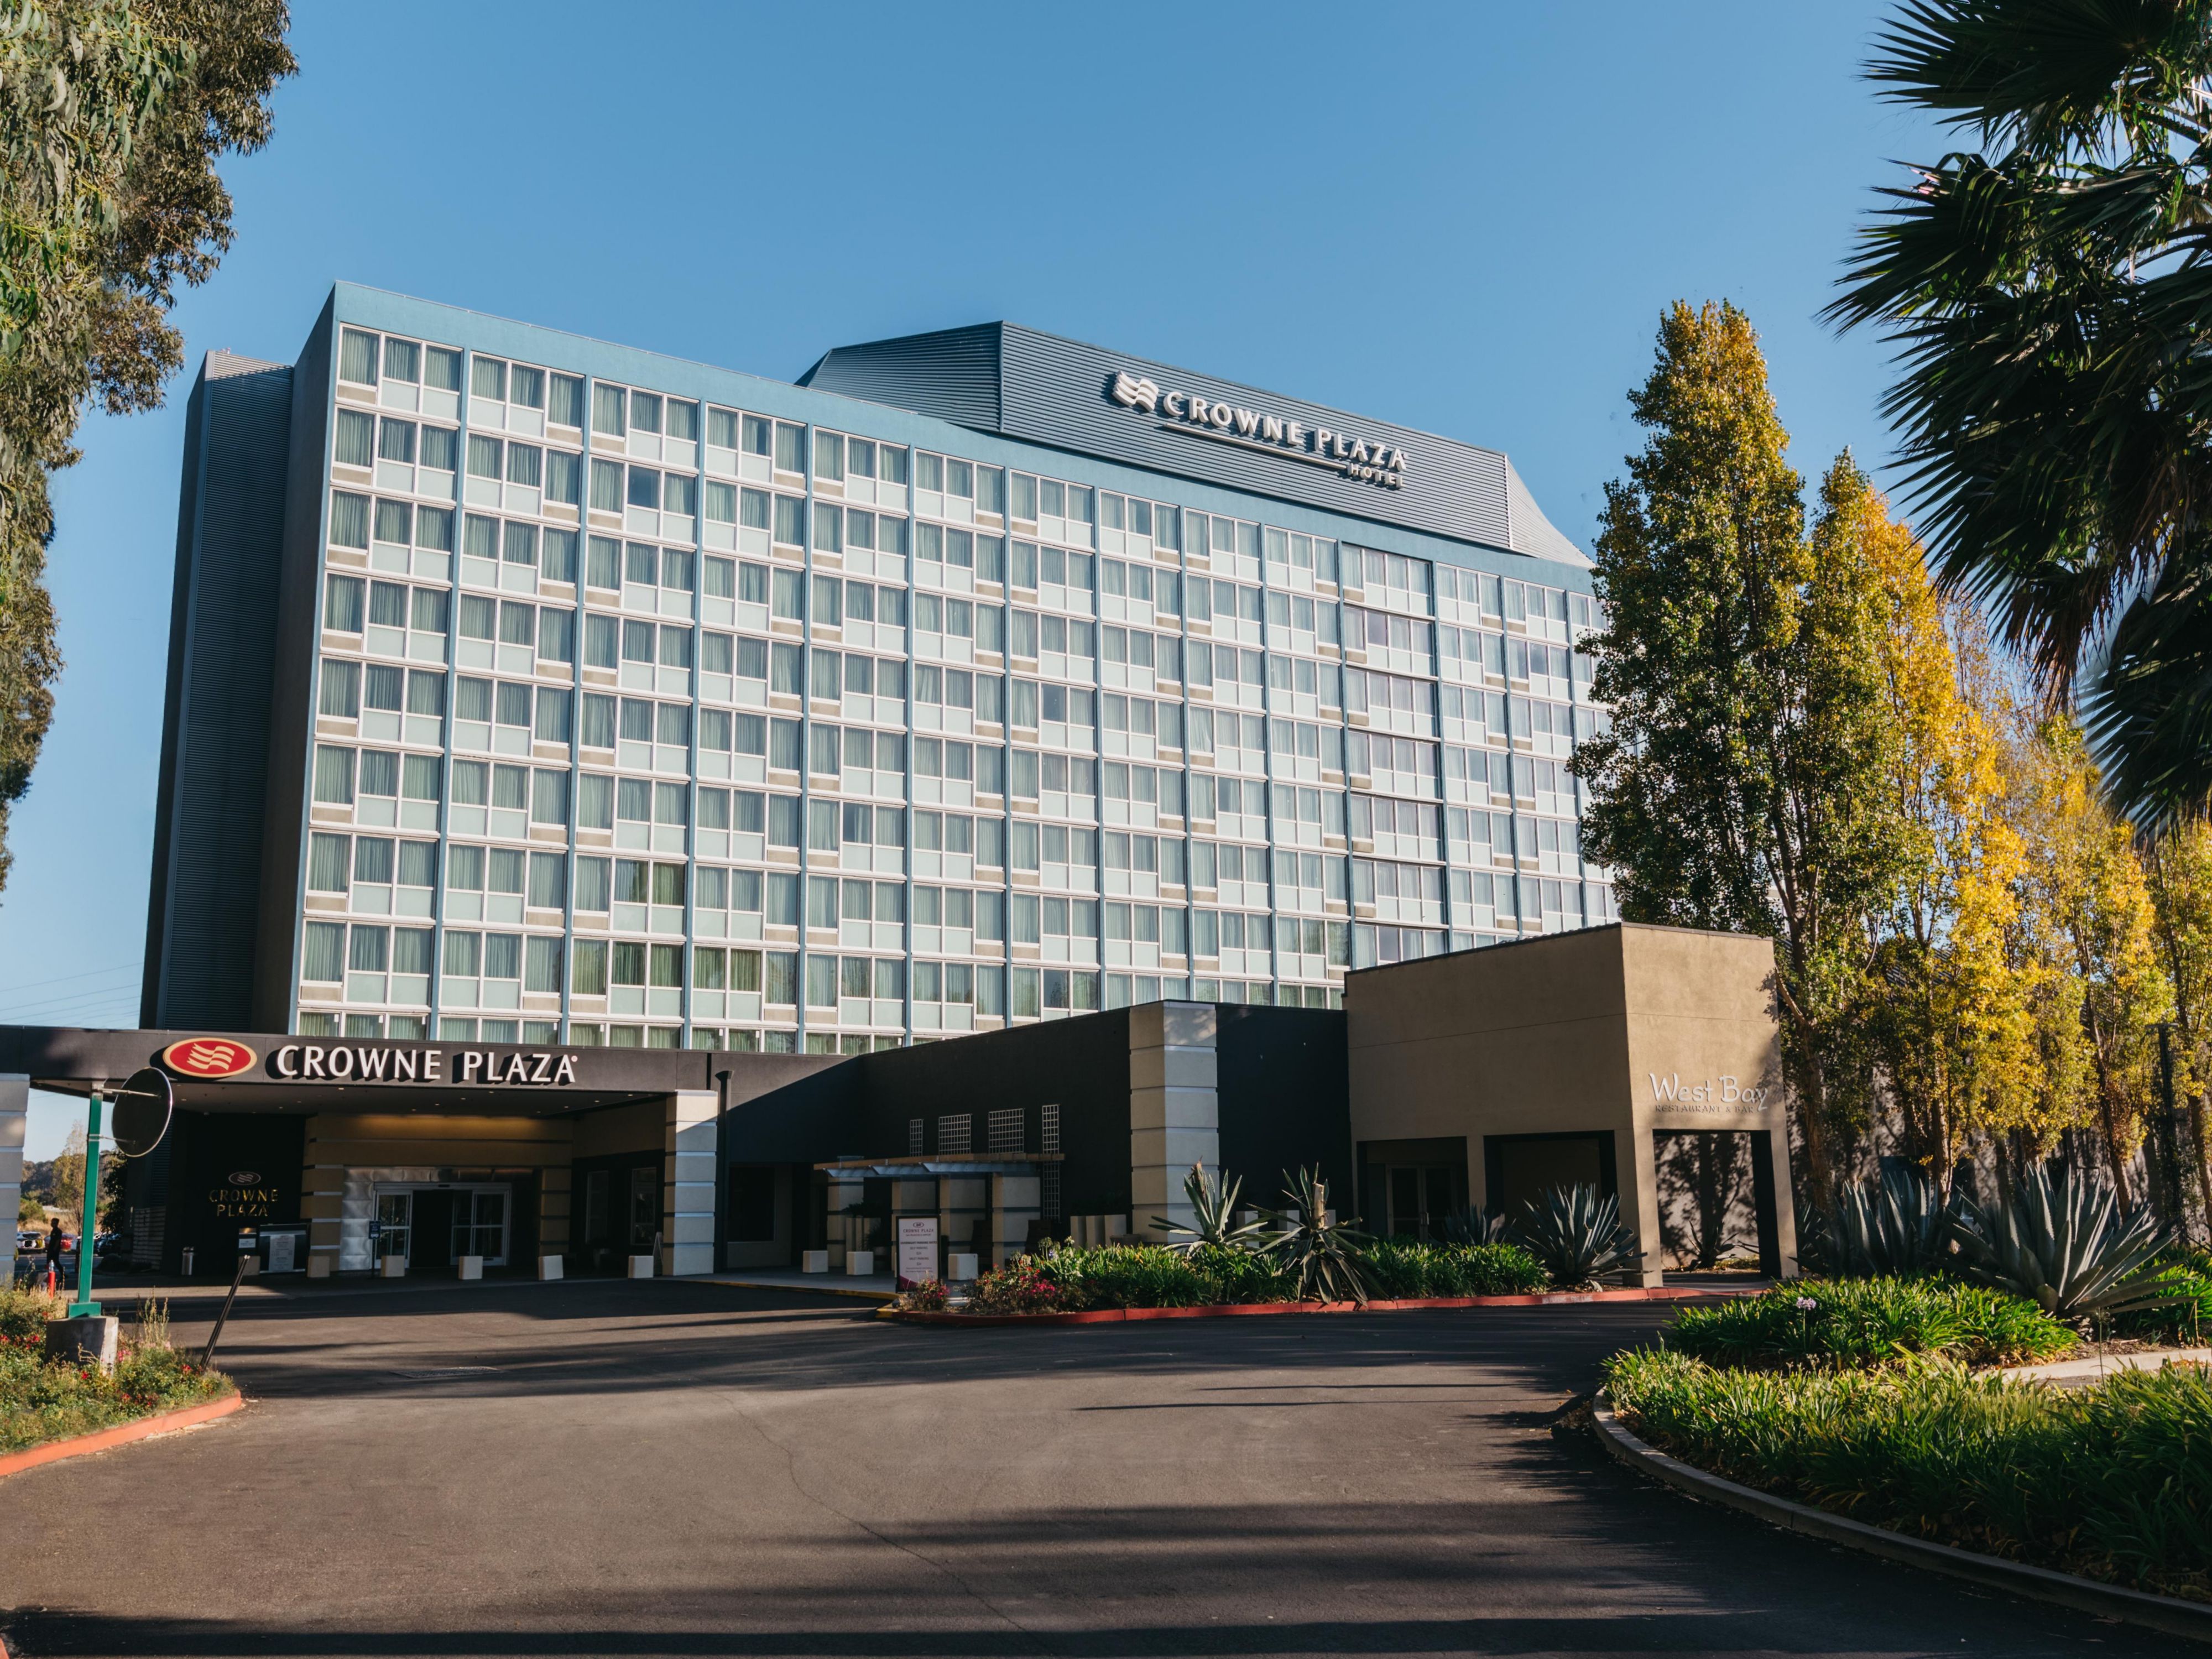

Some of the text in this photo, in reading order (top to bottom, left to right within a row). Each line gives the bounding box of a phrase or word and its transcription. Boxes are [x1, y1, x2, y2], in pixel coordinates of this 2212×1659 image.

[1164, 392, 1408, 471] CROWNE PLAZA
[1348, 462, 1406, 489] HOTEL
[277, 1045, 578, 1083] CROWNE PLAZA
[1648, 1073, 1768, 1111] West Bay
[1655, 1105, 1720, 1113] RESTAURANT
[209, 1190, 278, 1217] CROWNE PLAZA
